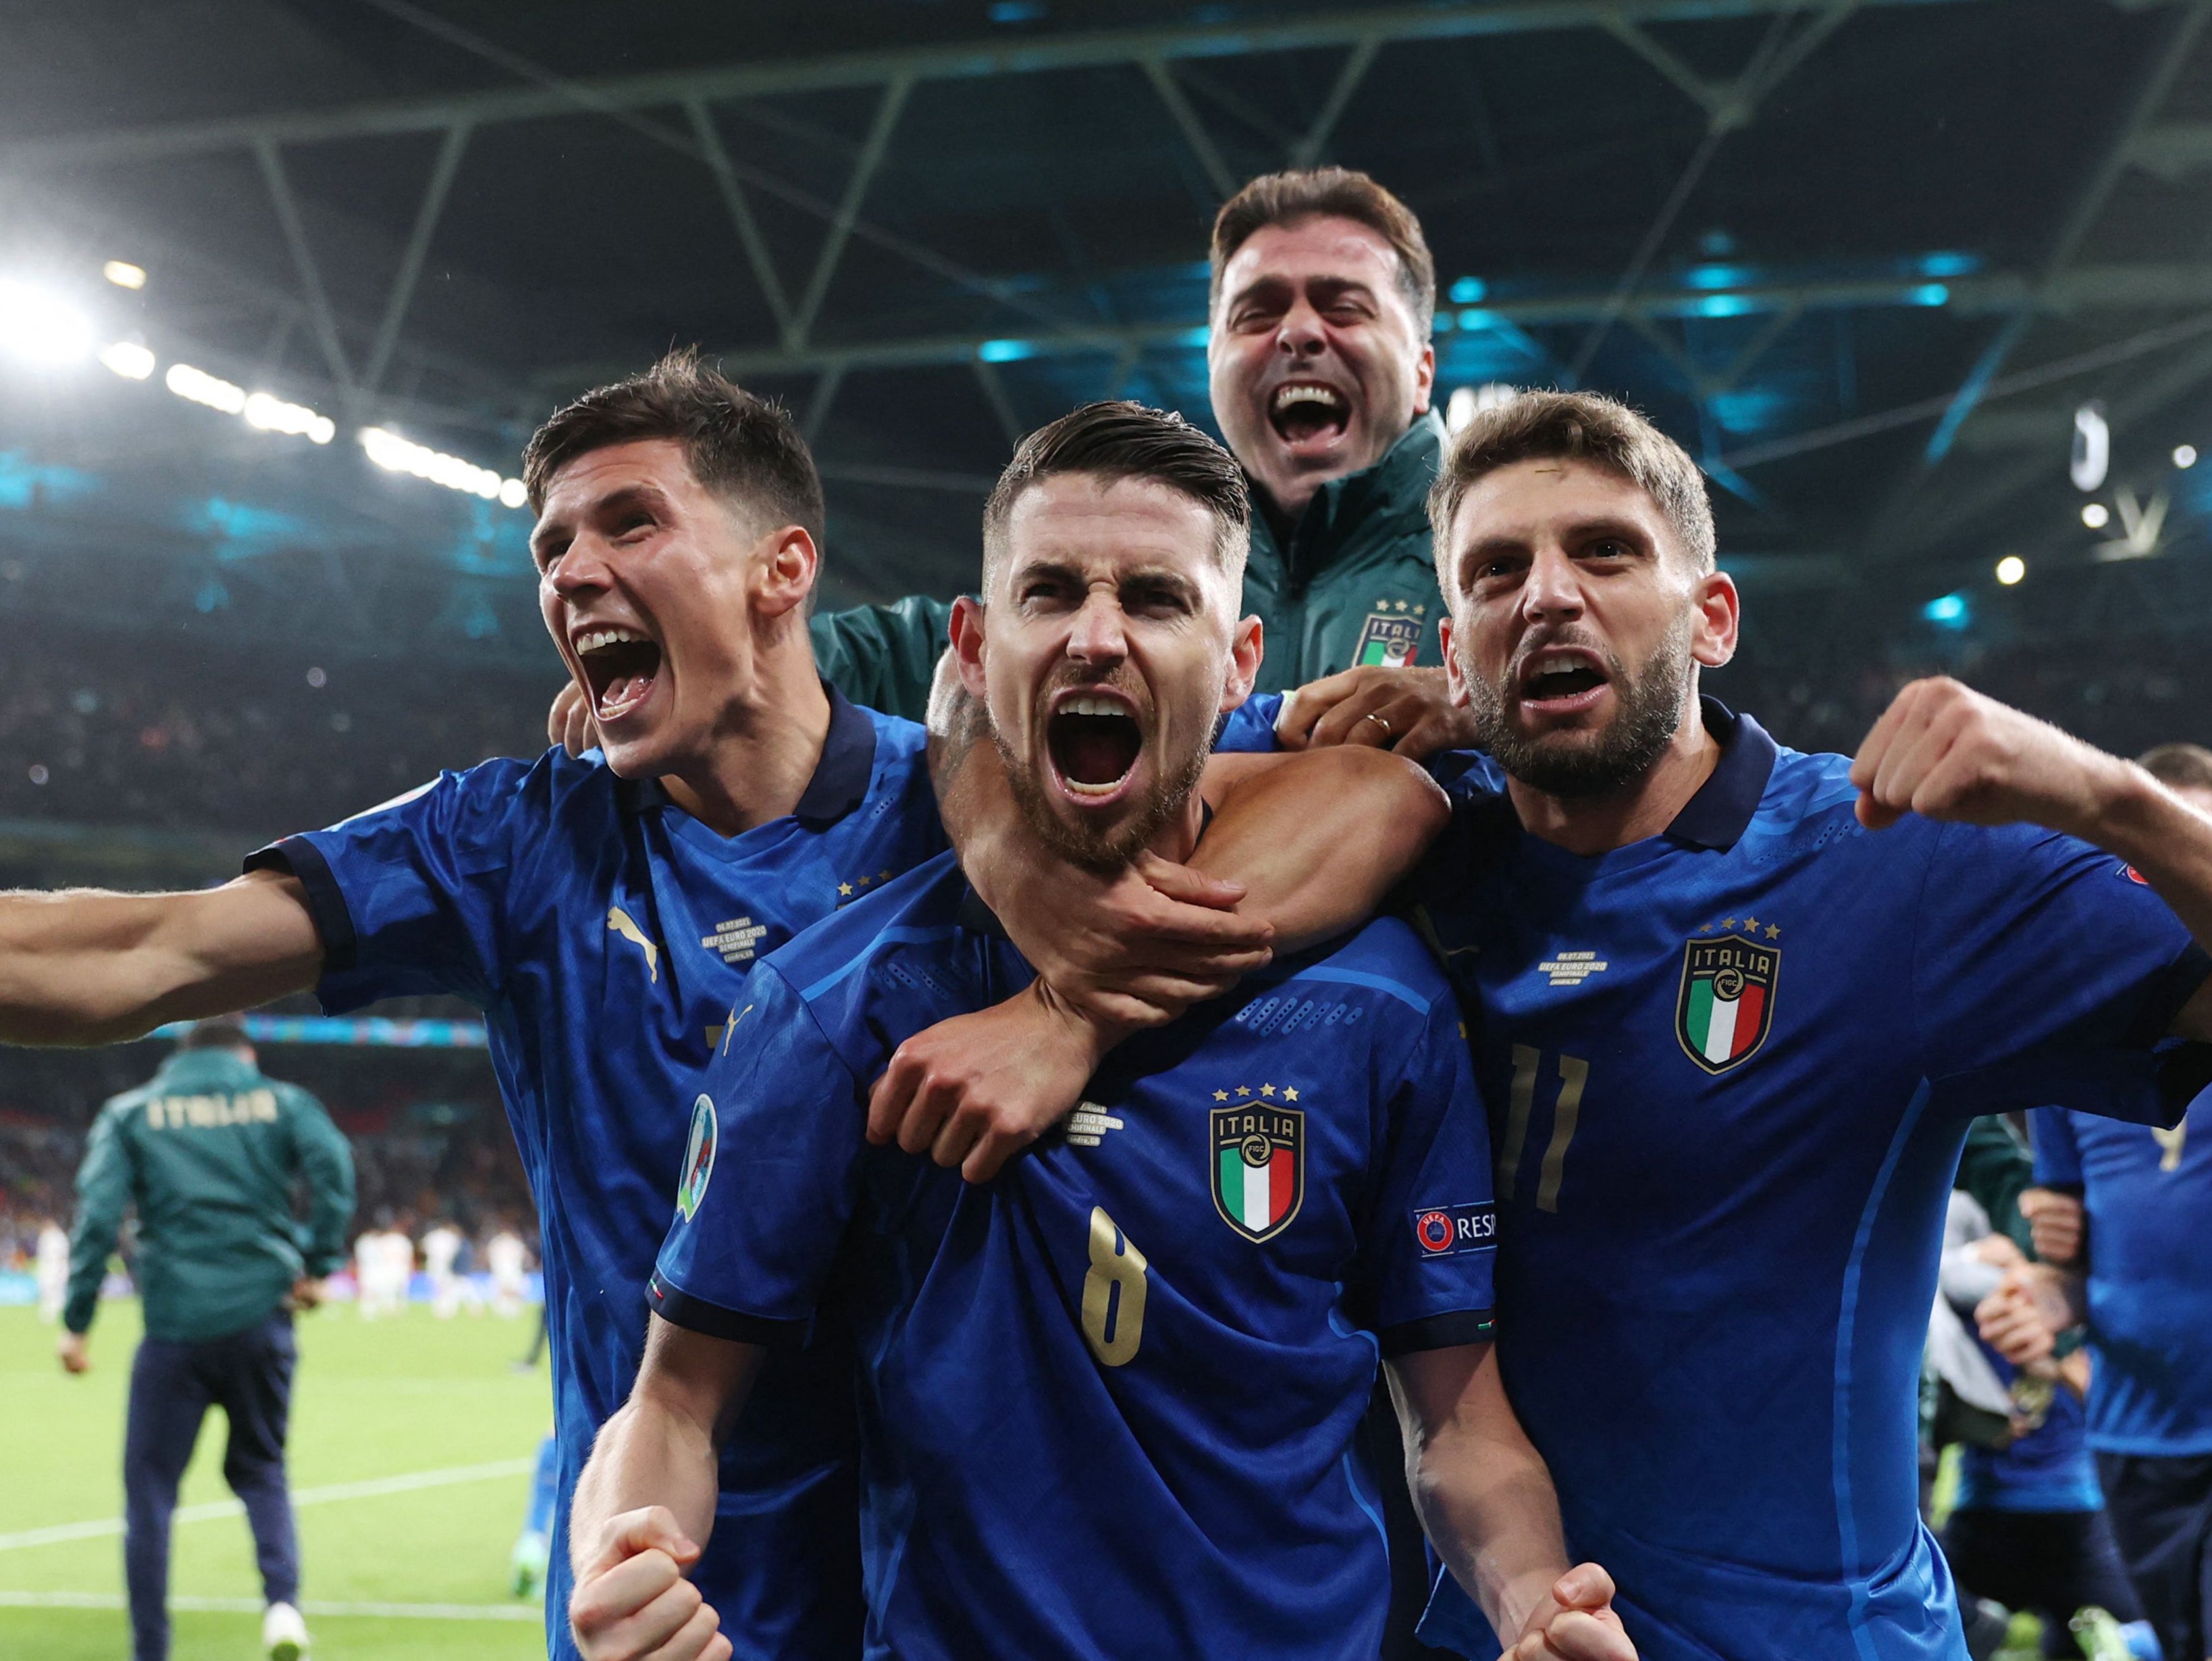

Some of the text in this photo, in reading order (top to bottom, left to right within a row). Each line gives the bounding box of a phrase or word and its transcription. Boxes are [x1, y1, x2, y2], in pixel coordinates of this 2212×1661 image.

[703, 926, 766, 947] UEFA EURO 2020
[1539, 962, 1606, 971] UEFA EURO 2020
[1695, 949, 1770, 974] ITALIA
[147, 1088, 277, 1131] ITALIA
[1098, 1117, 1122, 1128] 2020
[1219, 1115, 1294, 1137] ITALIA
[1499, 1043, 1589, 1214] 11
[1423, 1214, 1444, 1225] UEFA
[1082, 1205, 1147, 1367] 8
